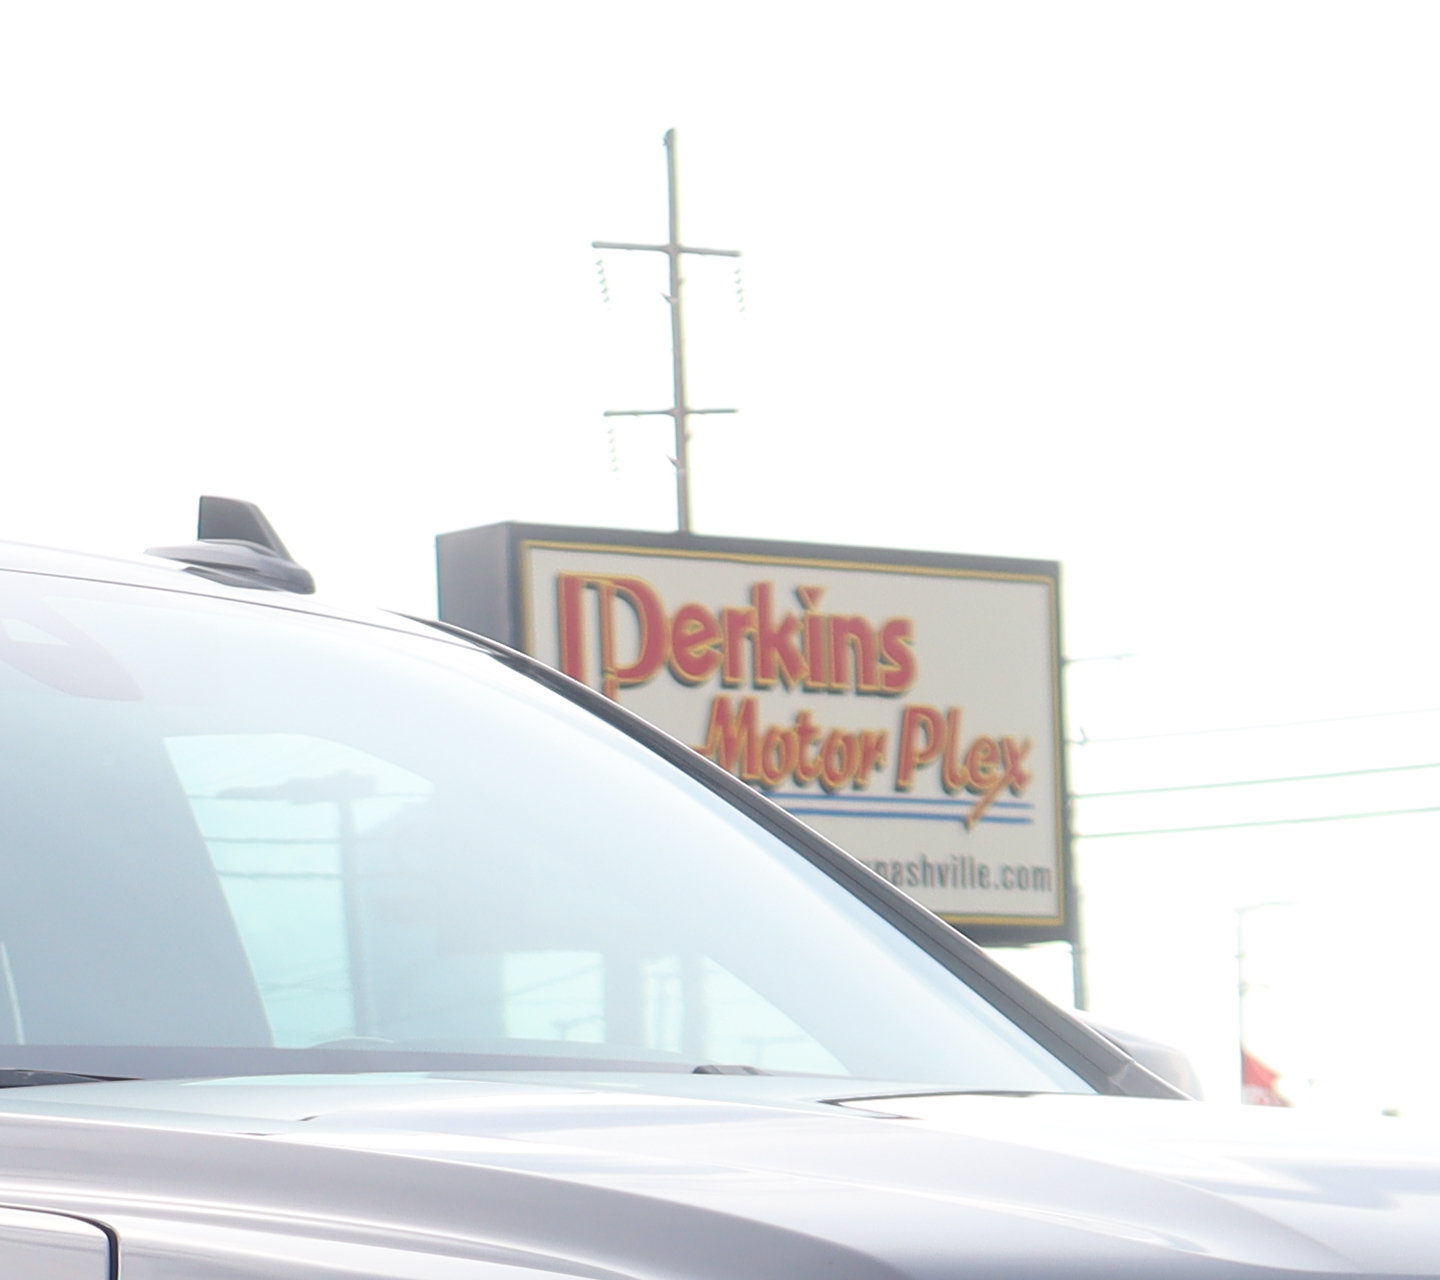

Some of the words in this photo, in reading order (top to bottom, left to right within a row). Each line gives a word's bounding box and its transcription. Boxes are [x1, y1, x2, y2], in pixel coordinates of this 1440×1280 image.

[556, 570, 917, 700] Perkins
[700, 695, 886, 793] Motor
[894, 704, 1035, 830] Plex
[868, 854, 1052, 892] nashville.com
